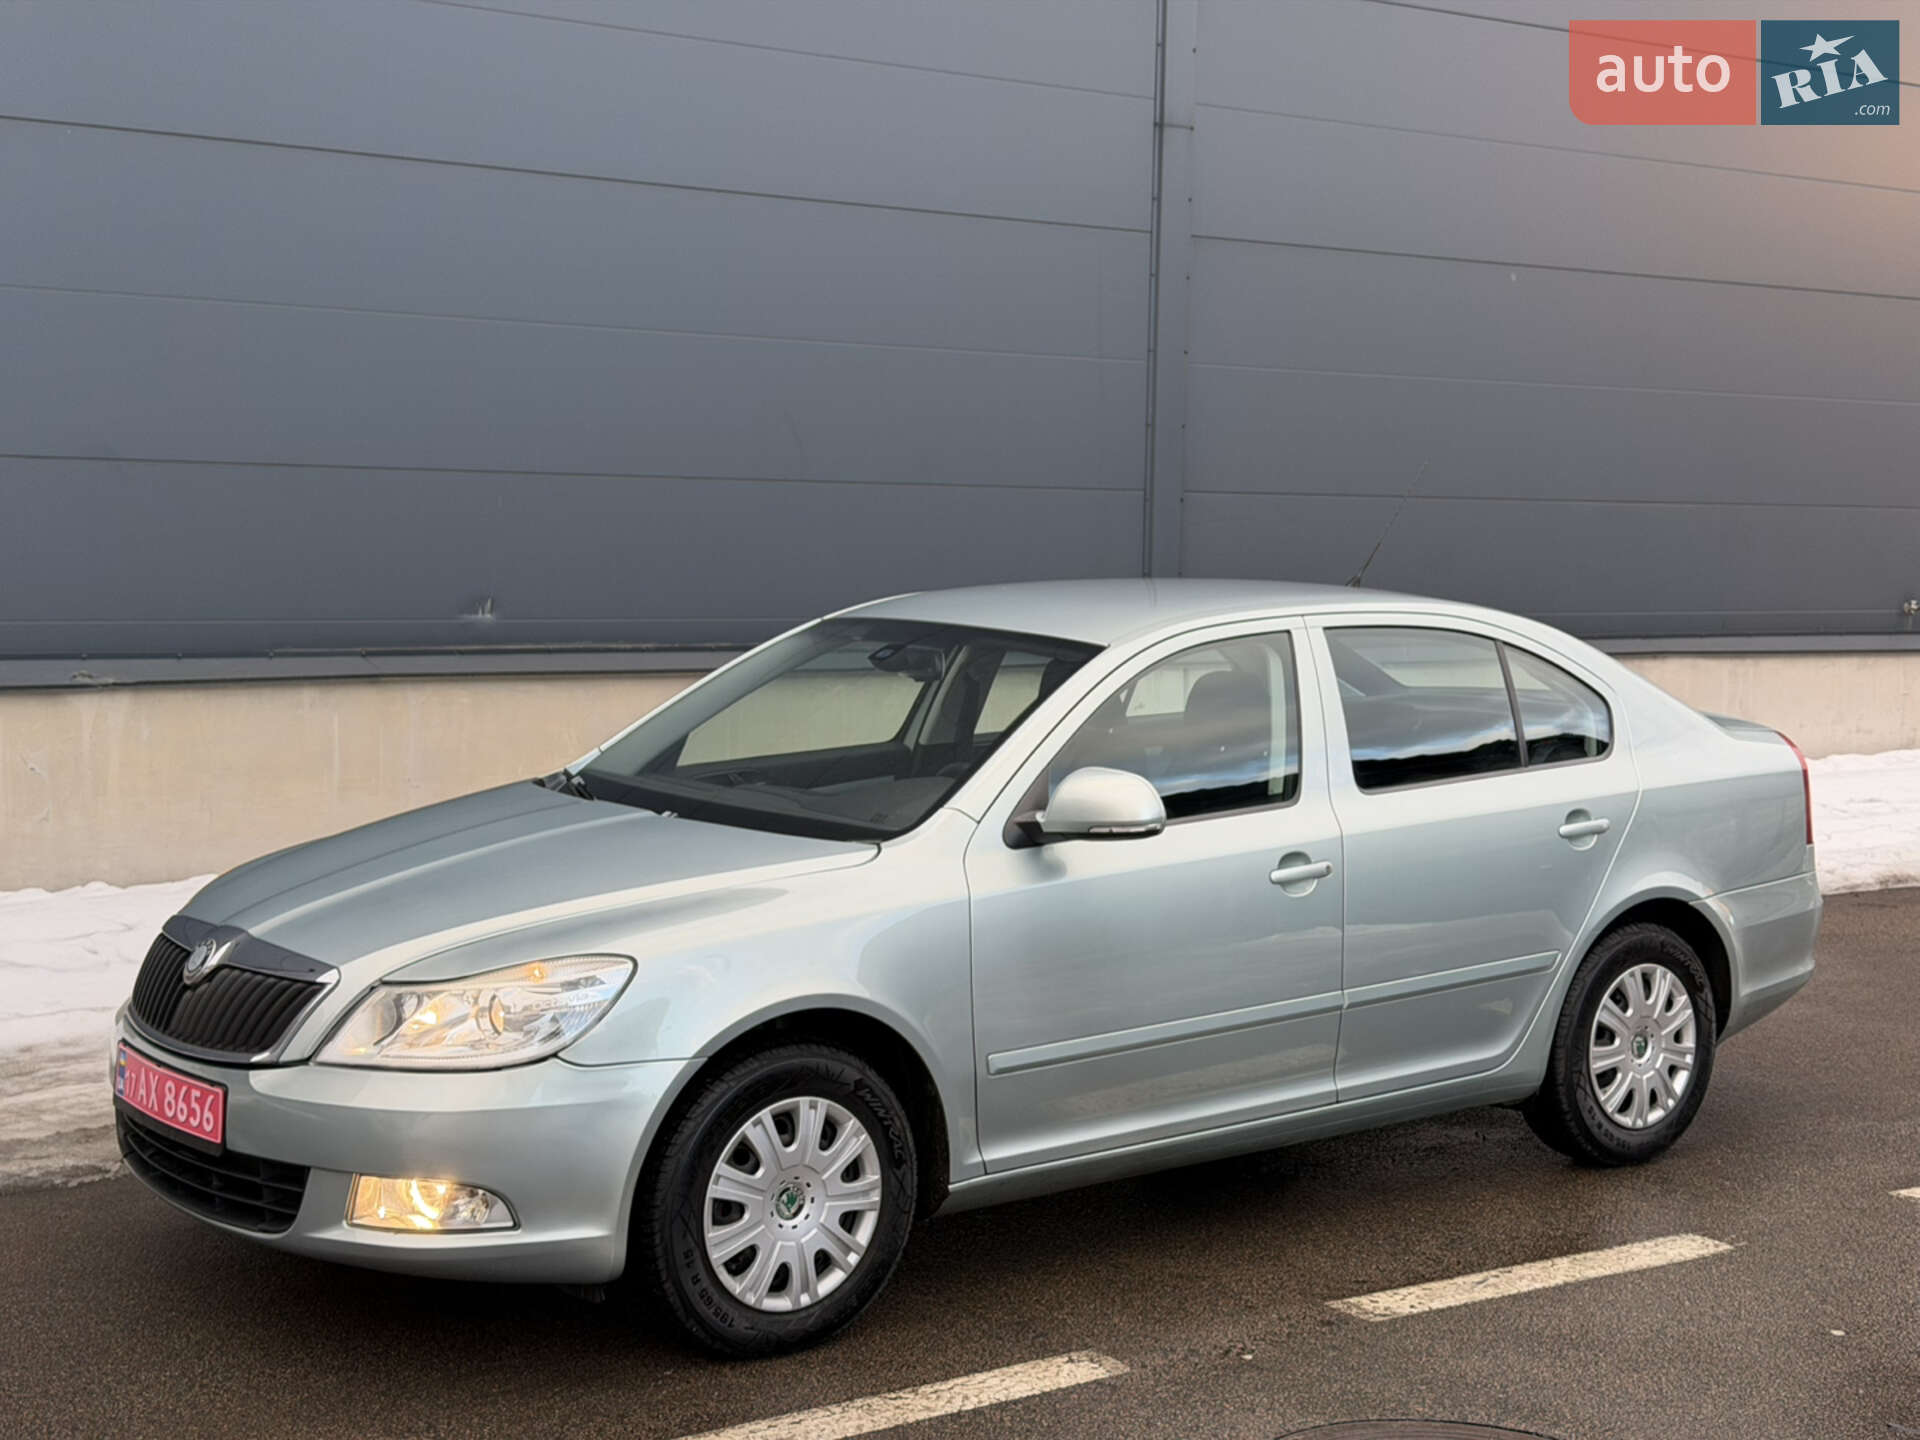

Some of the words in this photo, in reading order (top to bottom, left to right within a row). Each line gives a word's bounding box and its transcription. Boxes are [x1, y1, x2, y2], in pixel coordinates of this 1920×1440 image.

[164, 1080, 214, 1133] 8656
[682, 1249, 696, 1267] 15
[691, 1271, 702, 1287] R
